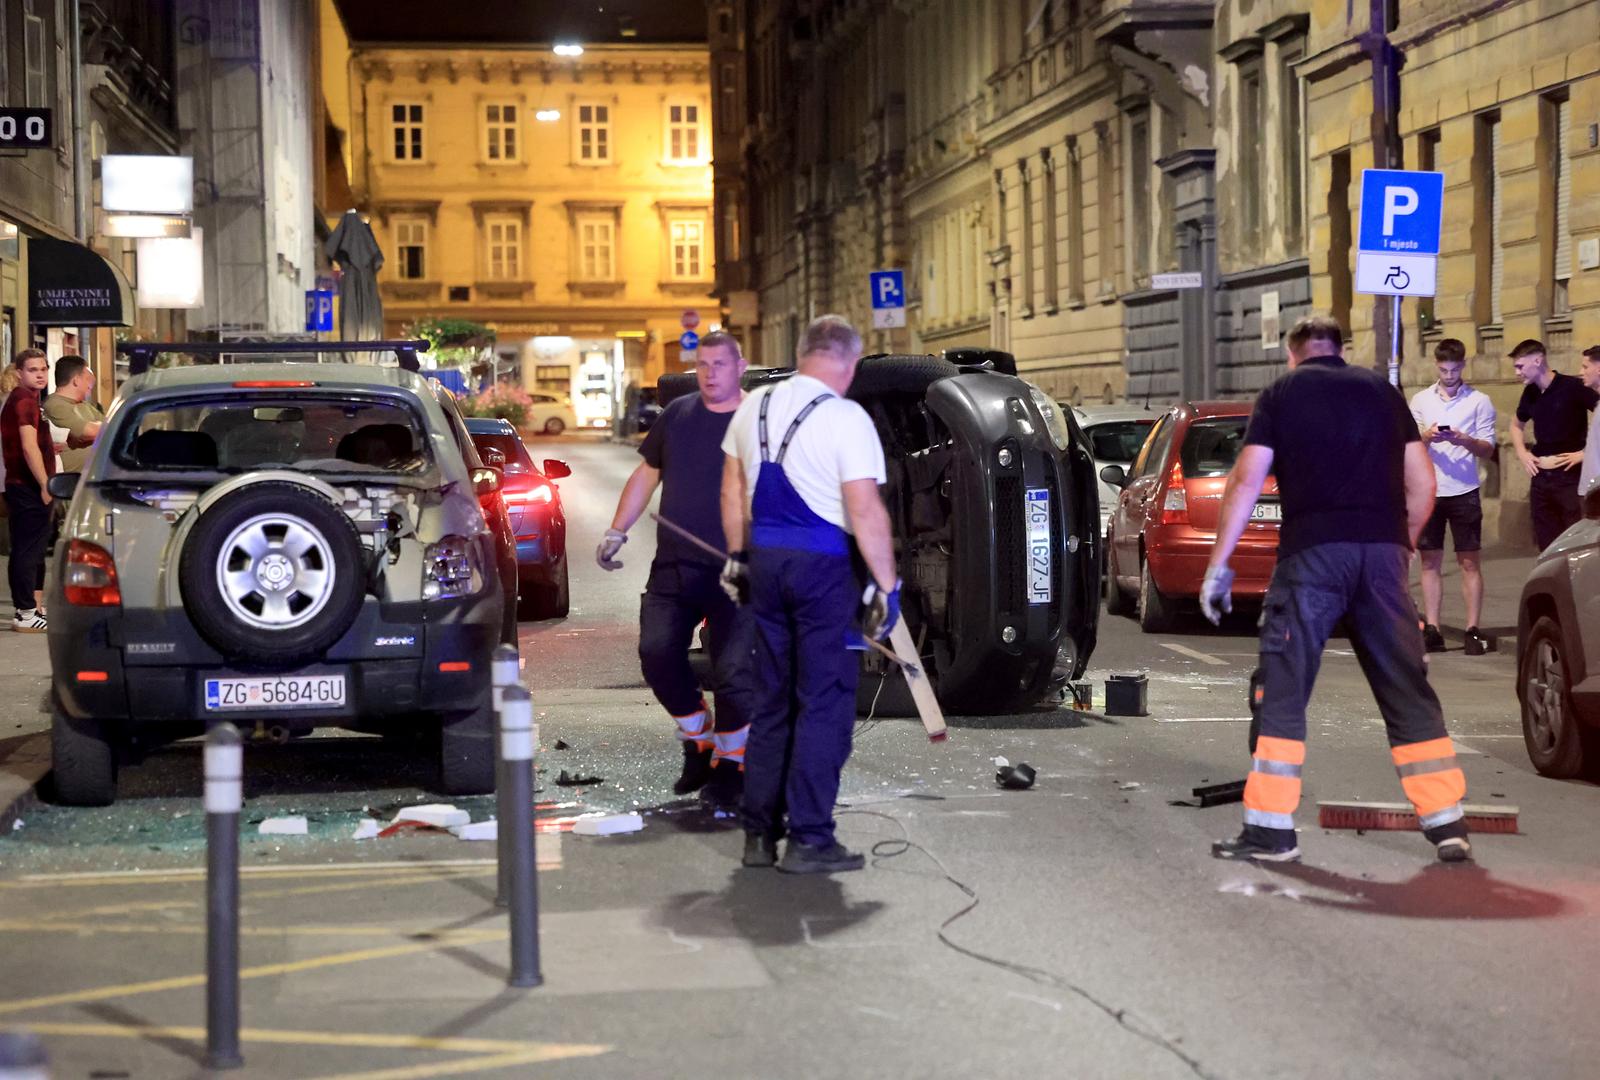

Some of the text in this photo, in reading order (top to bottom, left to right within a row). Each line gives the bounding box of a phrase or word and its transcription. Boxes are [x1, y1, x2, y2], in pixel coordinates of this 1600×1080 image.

[1382, 186, 1419, 236] P
[1390, 240, 1419, 250] mjesto
[38, 289, 102, 298] UMJETNINE
[39, 299, 110, 307] ANTIKVITETI
[319, 297, 331, 324] P
[1029, 503, 1048, 523] ZG
[222, 683, 247, 704] ZG
